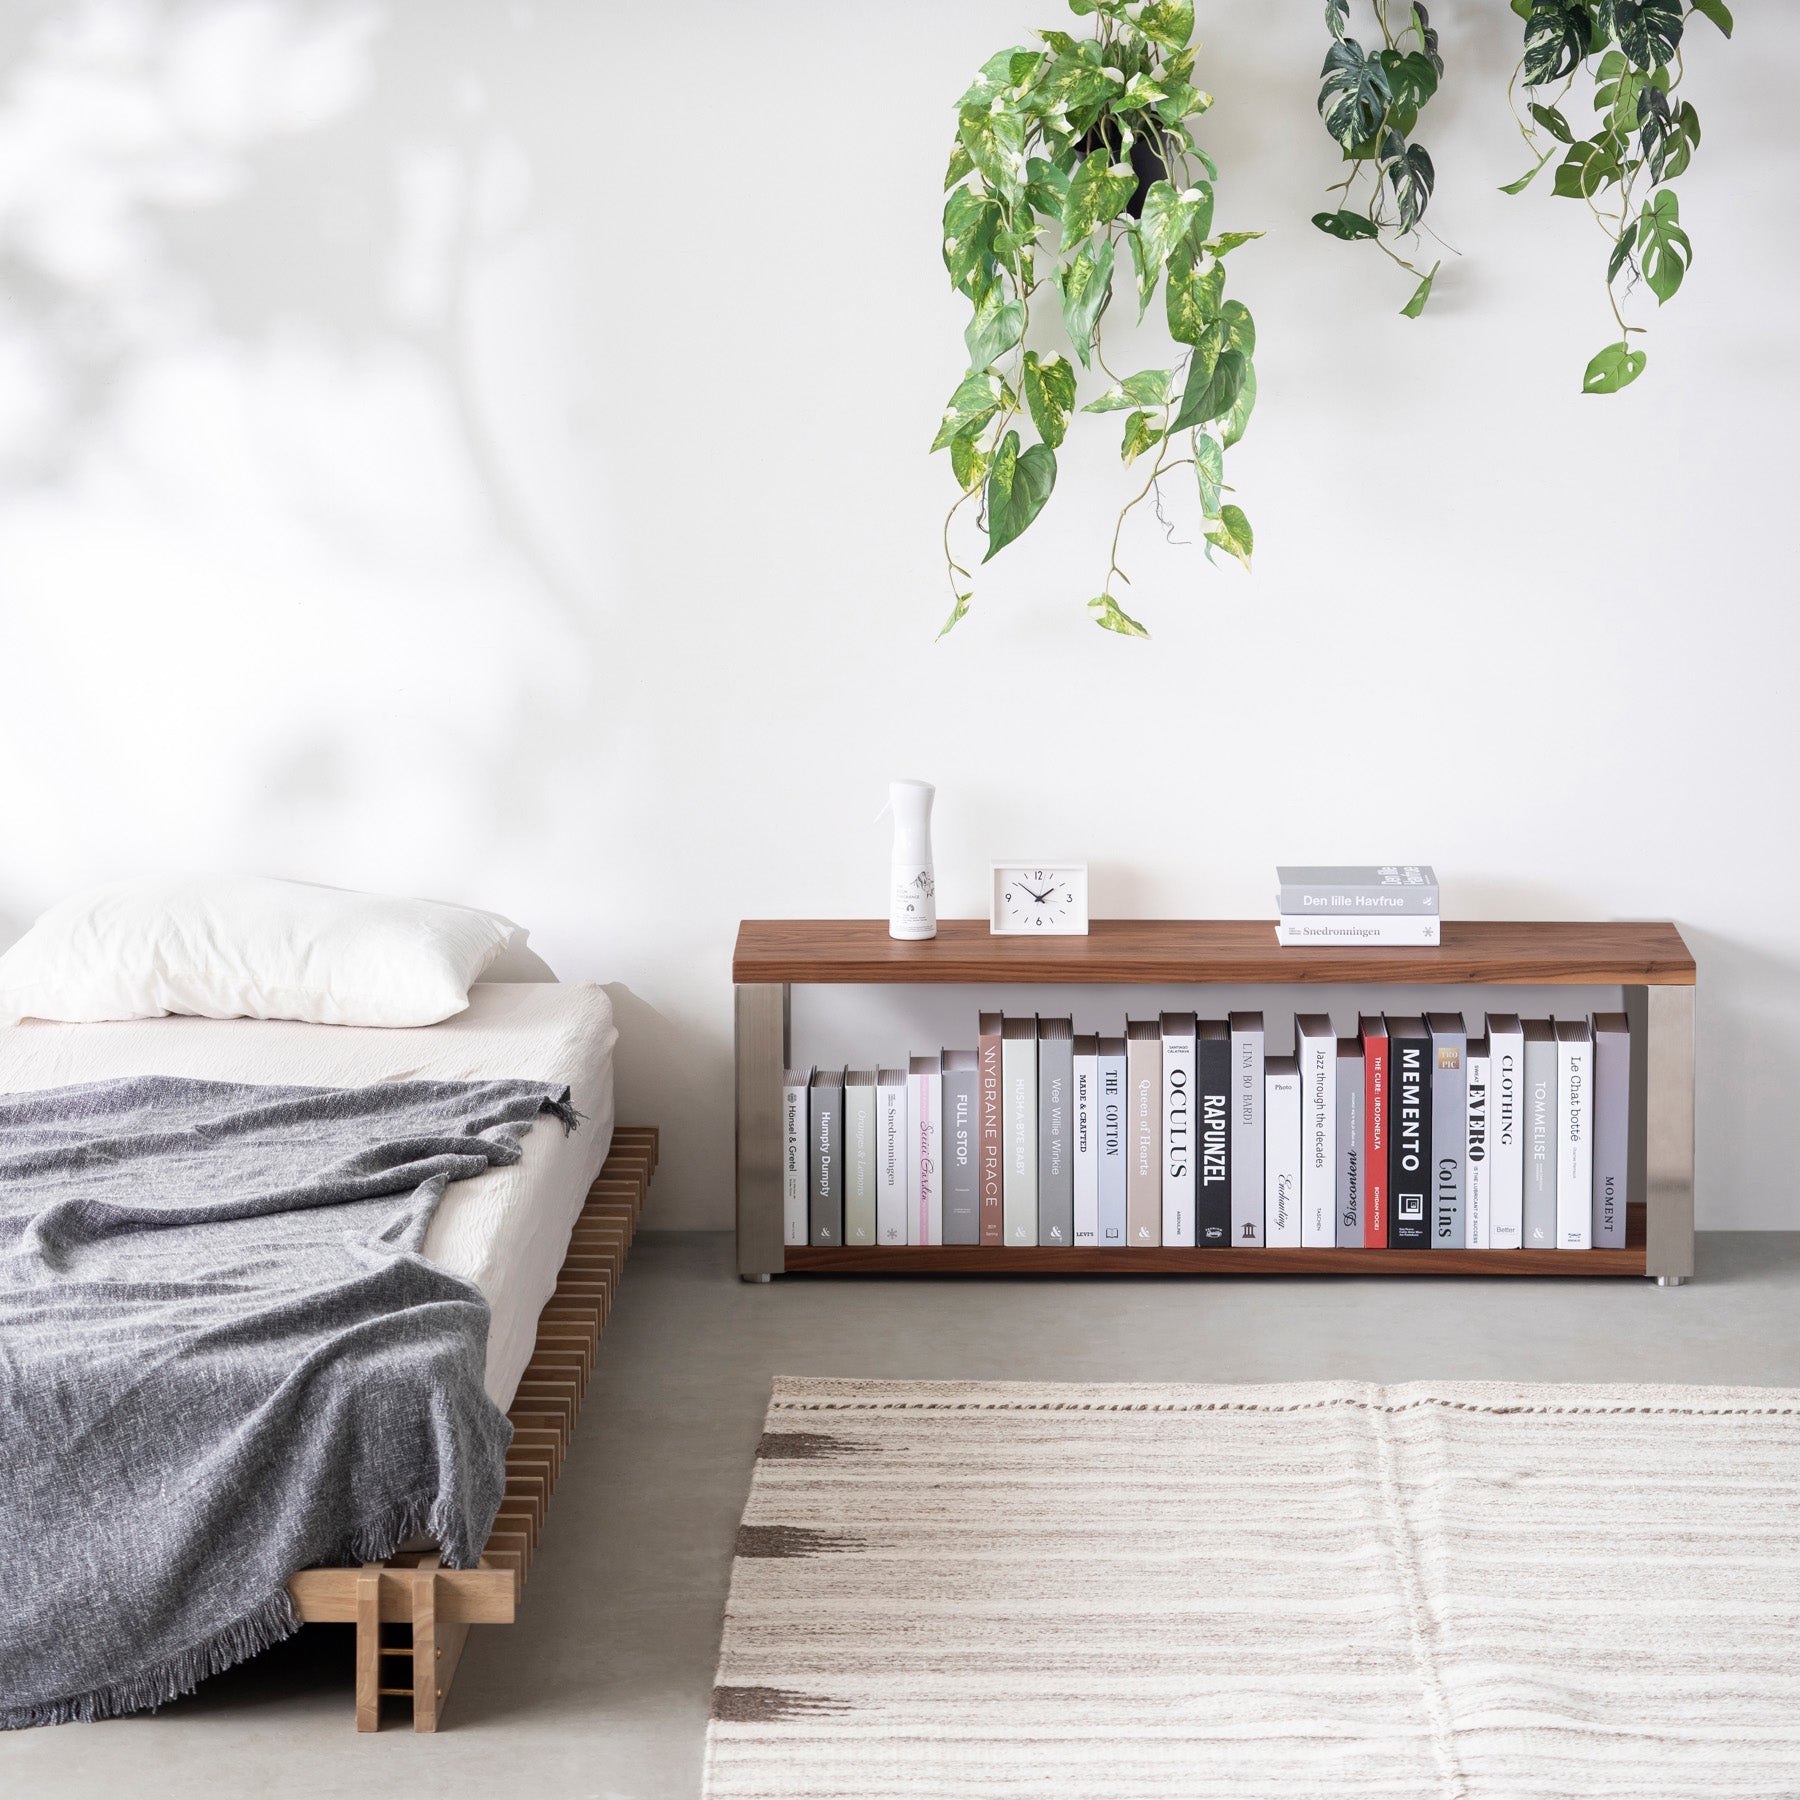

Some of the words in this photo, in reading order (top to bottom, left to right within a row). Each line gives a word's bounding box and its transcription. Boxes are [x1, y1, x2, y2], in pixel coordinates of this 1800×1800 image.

[1035, 871, 1042, 880] 12
[1006, 894, 1011, 902] 9
[1067, 894, 1072, 902] 3
[1304, 896, 1327, 905] Den
[1332, 896, 1351, 905] lille
[1356, 896, 1403, 906] Havfrue
[1036, 917, 1042, 926] 6
[1303, 927, 1380, 936] Snedronningen
[1243, 1043, 1252, 1068] LINA
[1316, 1051, 1326, 1069] Jazz
[1571, 1056, 1580, 1072] Le
[984, 1046, 997, 1139] WYBRANE
[1052, 1079, 1061, 1103] Wee
[1079, 1075, 1087, 1101] MADE
[1106, 1070, 1118, 1095] THE
[1139, 1080, 1150, 1116] Queen
[1244, 1075, 1253, 1089] BO
[1314, 1073, 1326, 1110] through
[1570, 1075, 1581, 1106] Chat
[956, 1095, 967, 1126] FULL
[1243, 1095, 1253, 1125] BARDI
[1402, 1049, 1419, 1171] MEMENTO
[1502, 1056, 1513, 1145] CLOTHING
[788, 1106, 797, 1134] Hänsel
[820, 1112, 830, 1153] Humpty
[856, 1111, 866, 1149] Oranges
[1052, 1108, 1061, 1135] Willie
[1106, 1105, 1118, 1156] COTTON
[1140, 1121, 1150, 1132] of
[1170, 1069, 1187, 1178] OCULUS
[1316, 1113, 1326, 1128] the
[1468, 1084, 1485, 1161] EVERO
[1534, 1082, 1546, 1160] TOMMELISE
[1571, 1109, 1582, 1142] botté
[887, 1108, 897, 1186] Snedronningen
[956, 1130, 967, 1167] STOP.
[1052, 1140, 1061, 1175] Winkie
[1140, 1136, 1150, 1176] Hearts
[1204, 1095, 1225, 1186] RAPUNZEL
[1315, 1132, 1325, 1168] decades
[820, 1156, 830, 1197] Dumpty
[857, 1161, 866, 1196] Lemons
[986, 1146, 997, 1207] PRACE
[1016, 1147, 1024, 1175] BABY
[921, 1158, 934, 1201] Garden
[1344, 1150, 1357, 1226] Discontent
[1439, 1159, 1457, 1238] Collins
[1604, 1176, 1614, 1232] MOMENT
